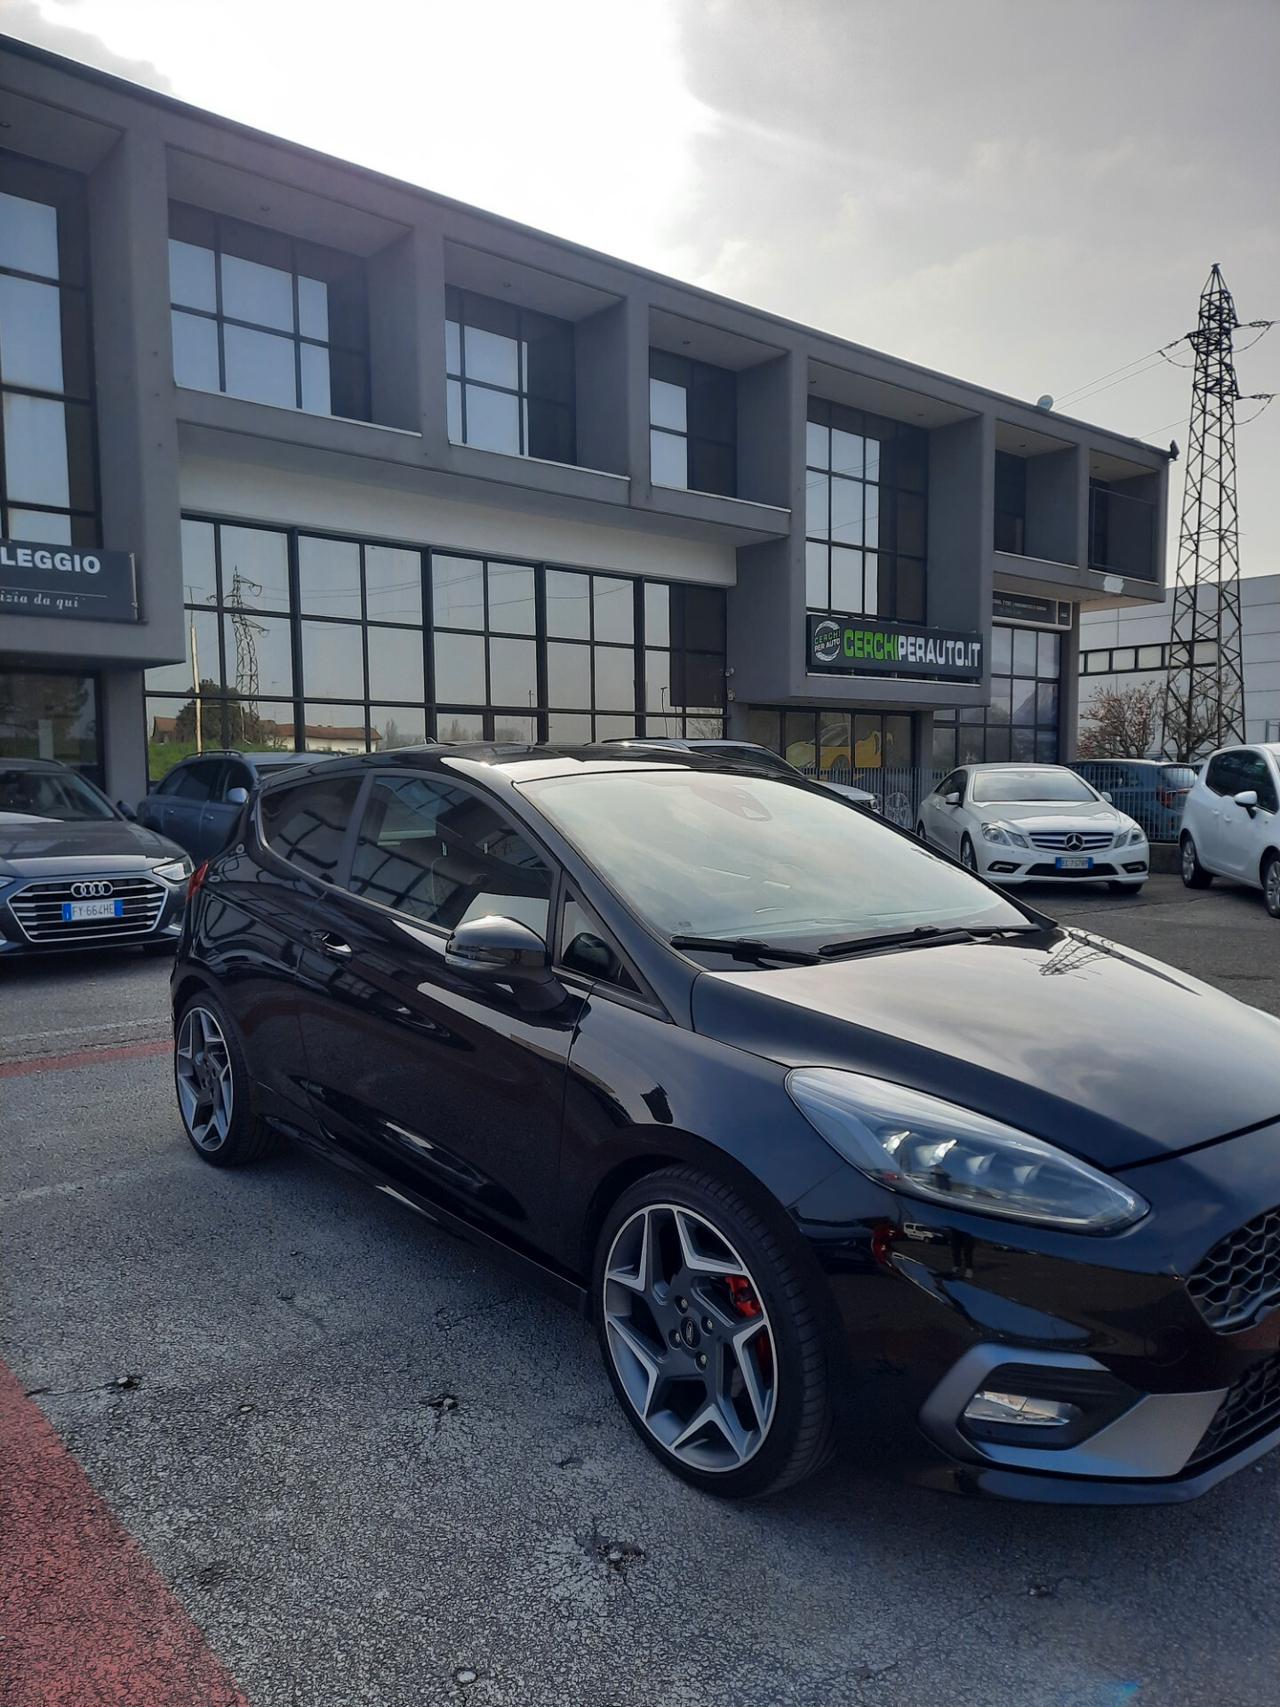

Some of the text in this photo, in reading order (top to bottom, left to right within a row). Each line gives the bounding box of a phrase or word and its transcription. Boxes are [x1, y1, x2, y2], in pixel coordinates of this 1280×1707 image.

[0, 546, 101, 574] LEGGIO
[34, 593, 51, 606] da
[56, 596, 79, 610] qui
[843, 628, 982, 668] CERCHIPERAUTO.IT
